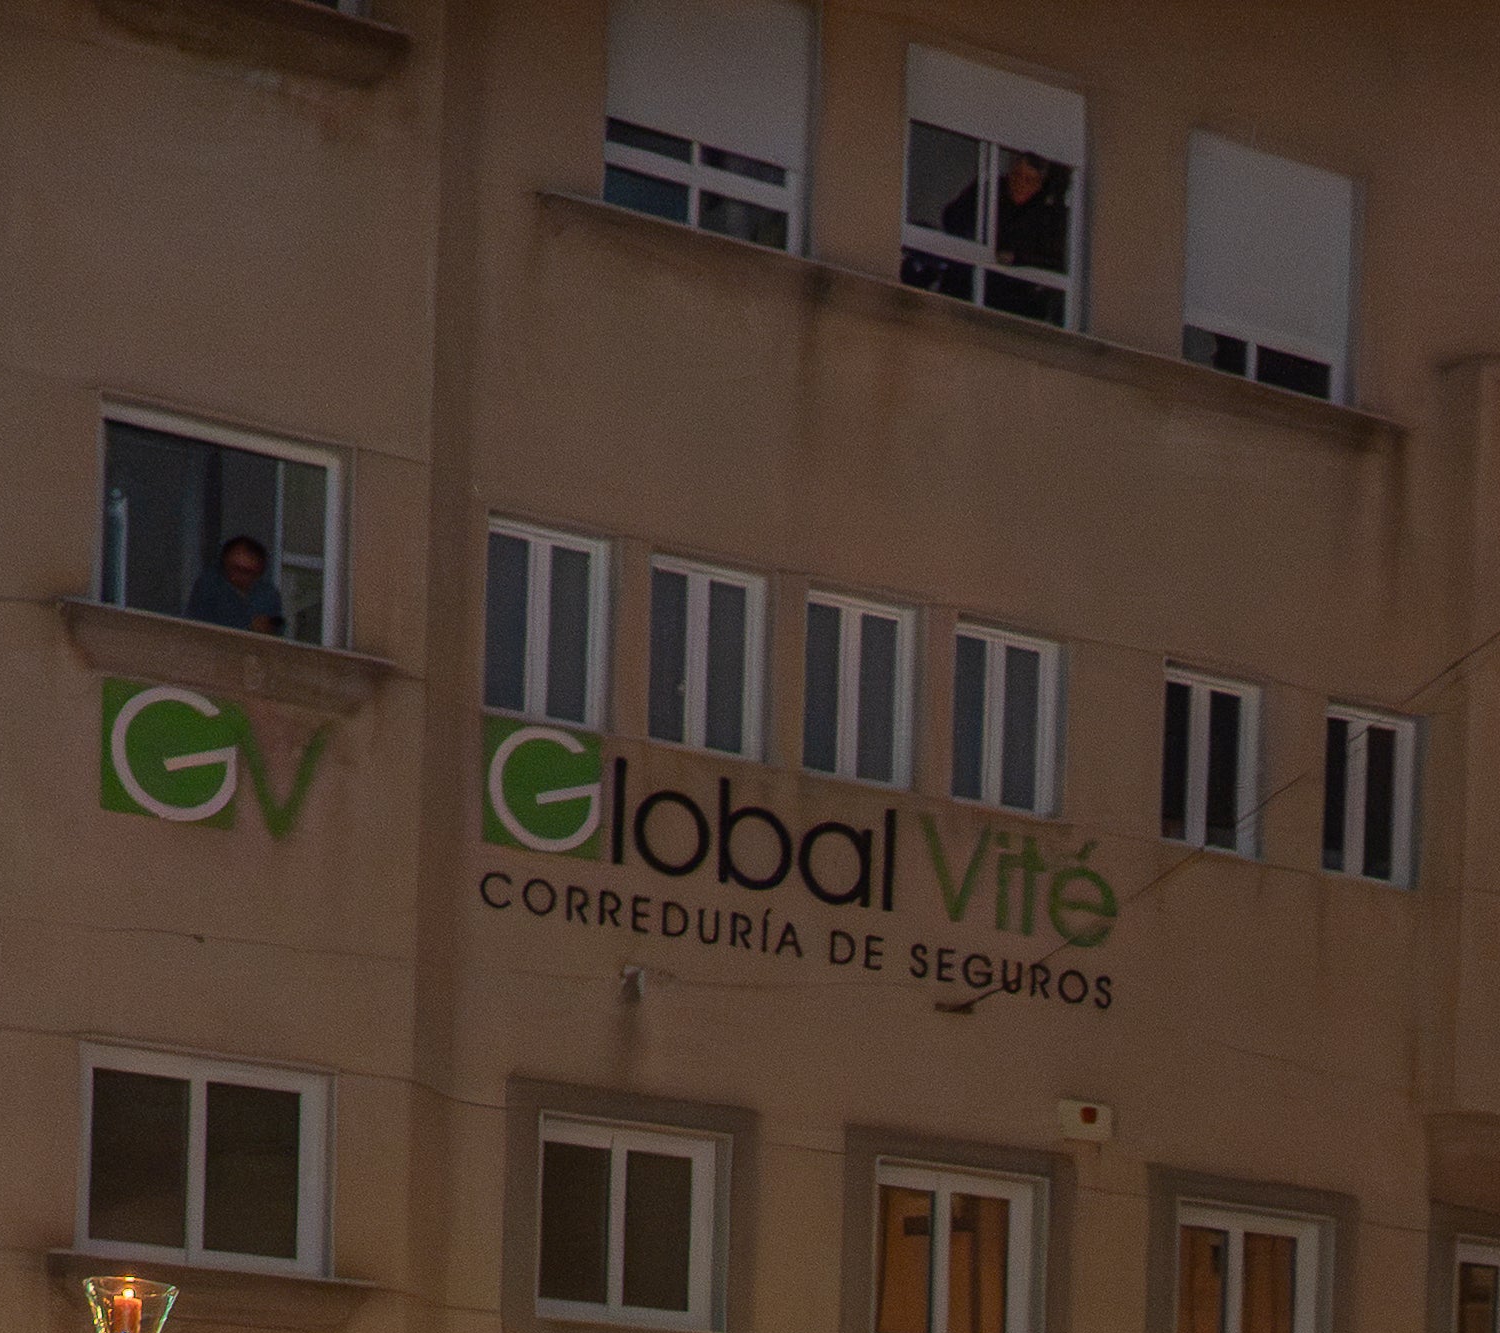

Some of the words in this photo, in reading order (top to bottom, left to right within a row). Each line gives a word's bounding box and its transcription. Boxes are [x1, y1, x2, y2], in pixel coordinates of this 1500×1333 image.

[111, 685, 339, 840] GV
[487, 725, 898, 912] Global
[922, 811, 1118, 947] Vité
[479, 871, 802, 958] CORREDURÍA
[829, 930, 885, 971] DE
[909, 943, 1114, 1011] SEGUROS
